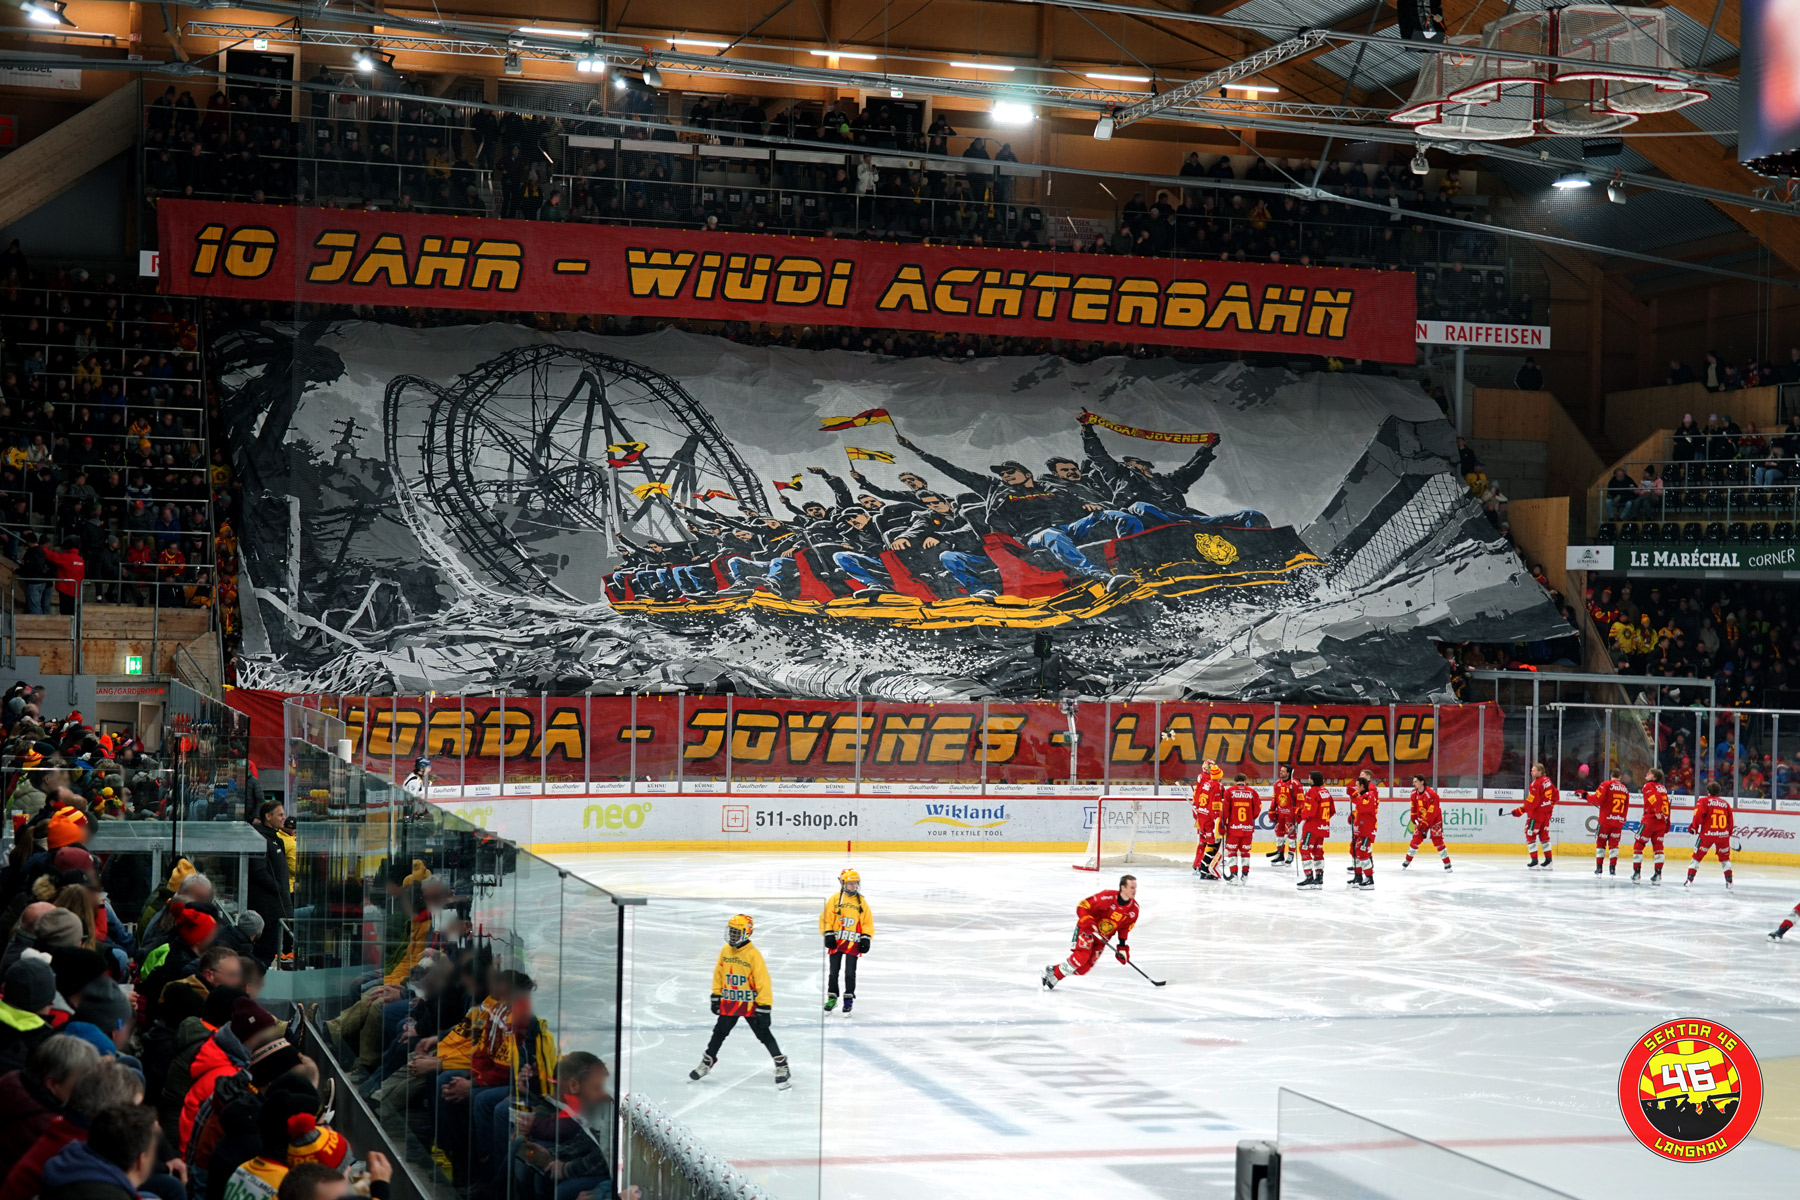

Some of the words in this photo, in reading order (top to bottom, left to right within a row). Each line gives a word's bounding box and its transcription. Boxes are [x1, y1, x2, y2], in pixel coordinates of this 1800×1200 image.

[191, 223, 279, 279] 10
[306, 230, 524, 291] JAHR
[875, 264, 1355, 338] ACHTERBAHN
[1445, 324, 1542, 345] RAIFFEISEN
[1145, 432, 1209, 443] JOVENES
[1748, 548, 1796, 567] CORNER
[682, 708, 1029, 765] JOVENES
[1110, 712, 1440, 767] LANGNAU
[755, 810, 858, 830] 511-shop.ch
[1237, 807, 1247, 822] 6
[1442, 807, 1484, 825] tähli
[1710, 814, 1727, 829] 10
[725, 973, 747, 987] TOP
